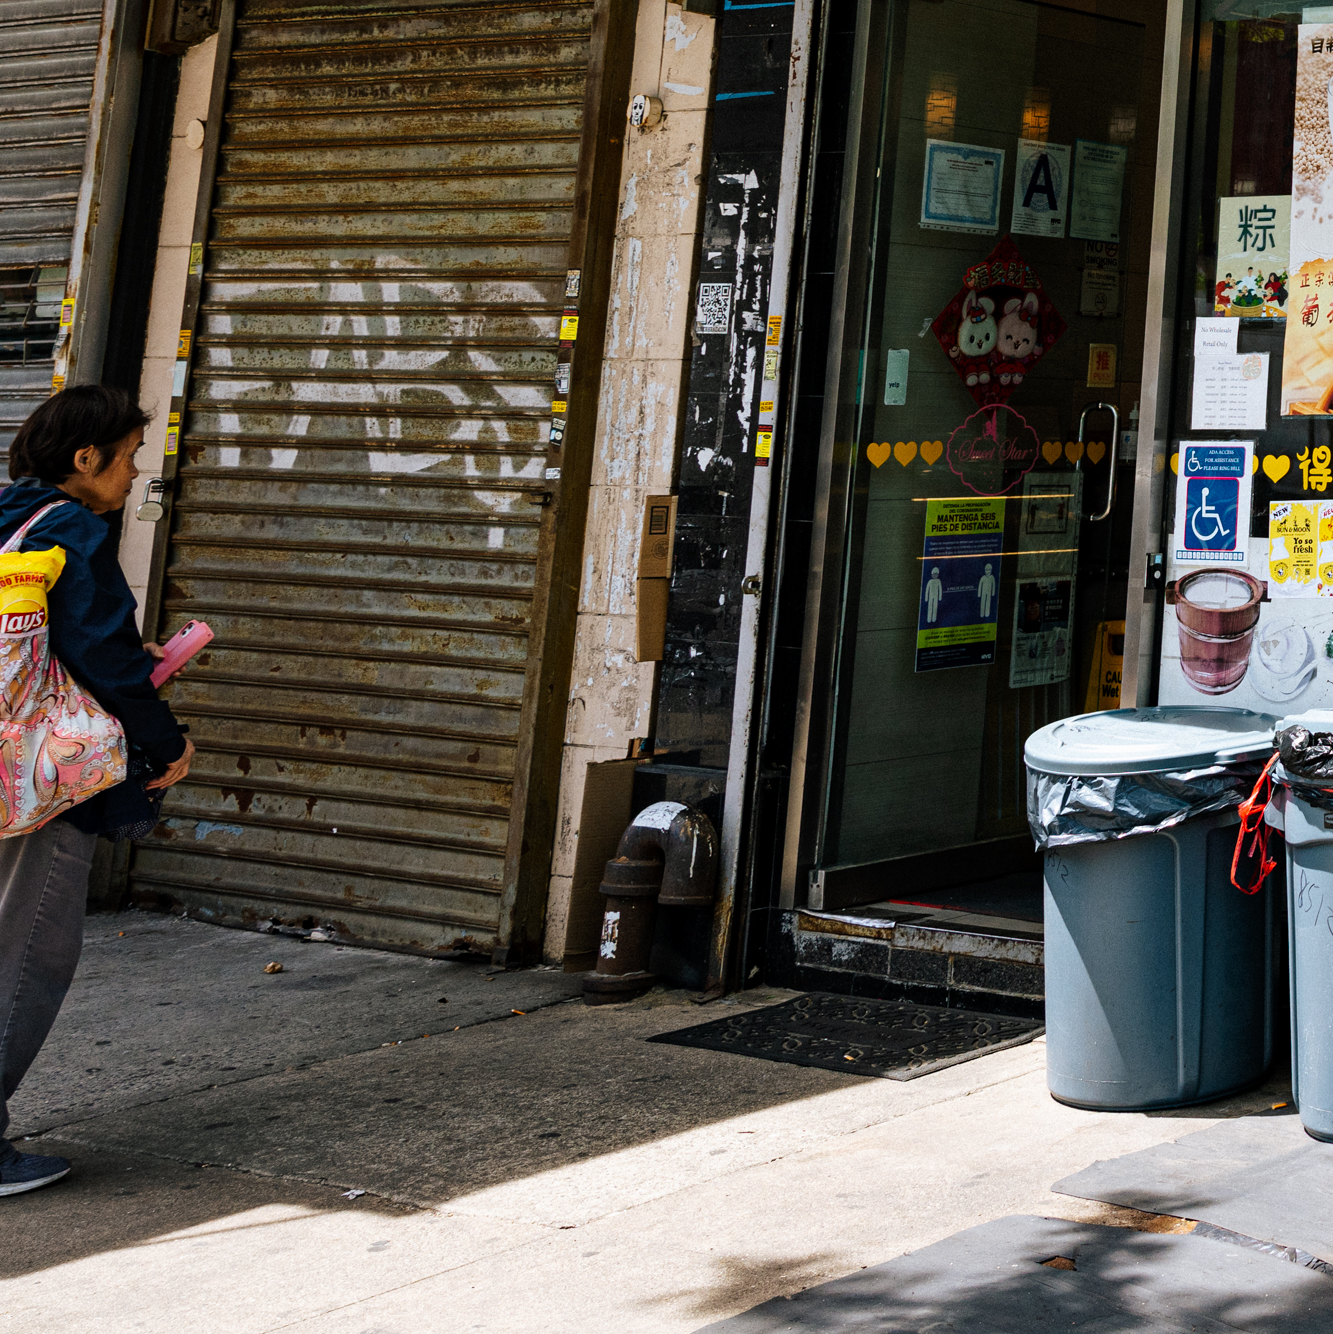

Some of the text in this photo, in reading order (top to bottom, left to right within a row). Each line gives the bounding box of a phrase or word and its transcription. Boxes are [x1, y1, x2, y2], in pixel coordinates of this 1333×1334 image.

[1022, 153, 1058, 211] A
[1237, 205, 1277, 252] 粽
[1086, 240, 1103, 253] NO
[1085, 255, 1117, 267] SMOKING
[937, 512, 996, 523] MANTENGA SEIS
[1273, 506, 1289, 519] NEW
[931, 520, 1000, 532] PIES DE DISTANCIA
[1293, 537, 1303, 545] Yo
[1293, 545, 1314, 554] fresh
[15, 575, 44, 584] FARMS
[1102, 685, 1119, 698] Wet
